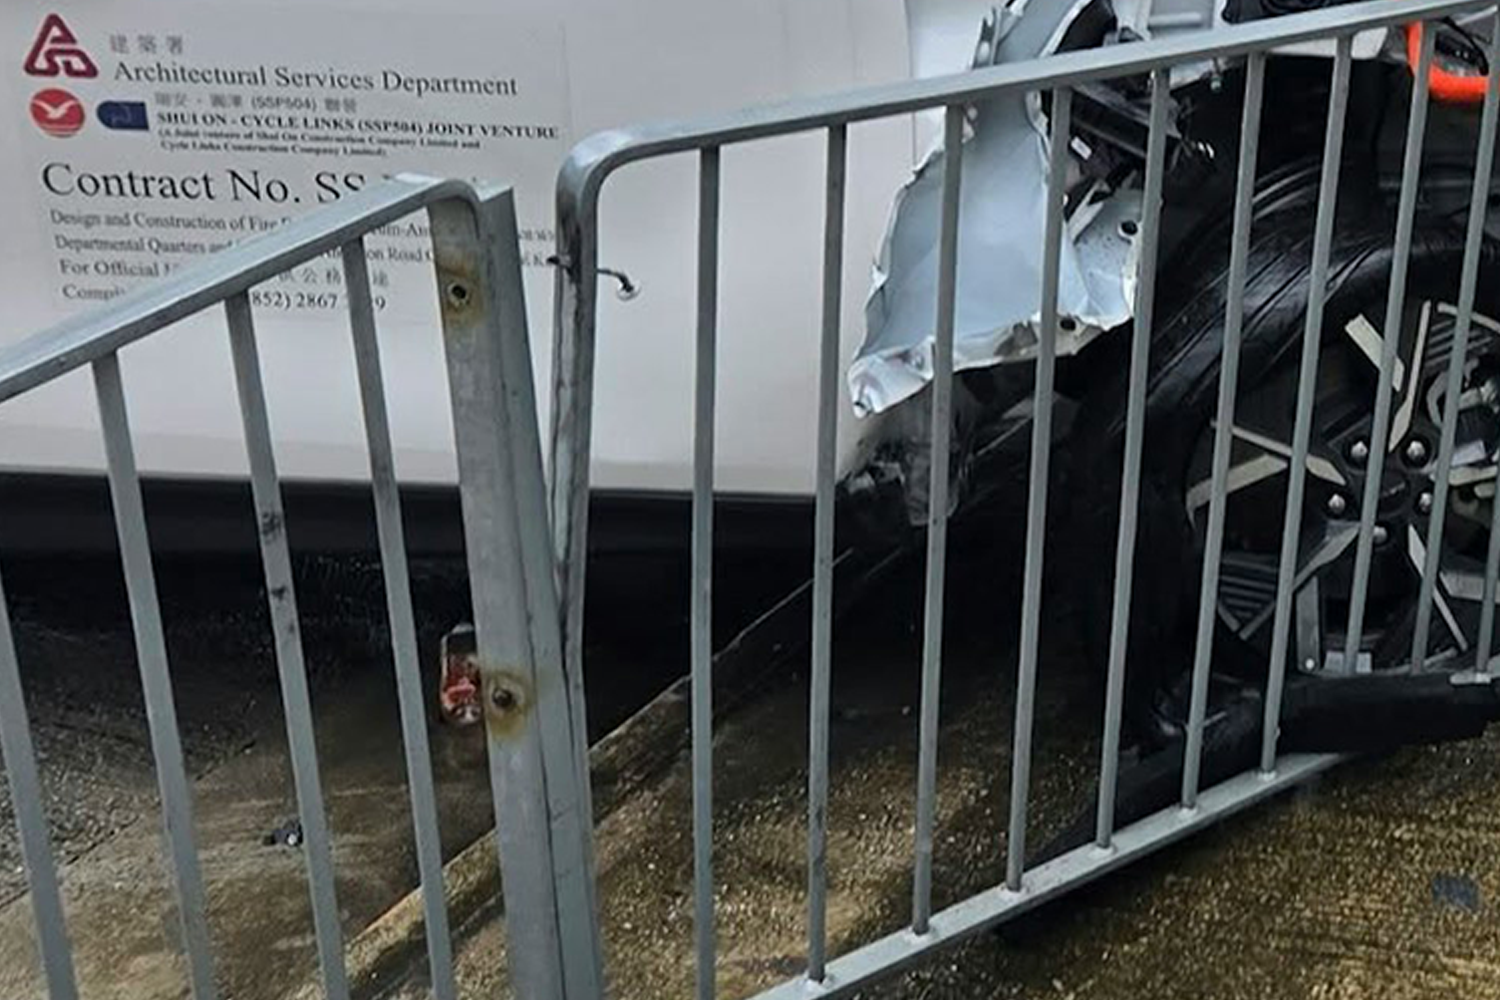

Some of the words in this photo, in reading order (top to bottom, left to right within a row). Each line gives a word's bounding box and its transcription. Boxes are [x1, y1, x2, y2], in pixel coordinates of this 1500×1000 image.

[114, 61, 267, 86] Architectural
[274, 67, 375, 89] Services
[382, 70, 518, 97] Department
[240, 115, 299, 129] CYCLE
[303, 117, 354, 131] LINKS
[426, 121, 476, 136] JOINT
[480, 123, 559, 139] VENTURE
[41, 161, 217, 201] Contract
[227, 168, 301, 204] No.
[51, 209, 101, 229] Design
[105, 211, 131, 227] and
[133, 212, 227, 231] Construction
[229, 214, 246, 231] of
[55, 234, 145, 253] Departmental
[148, 237, 206, 254] Quarters
[59, 259, 89, 275] For
[94, 260, 160, 278] Official
[296, 293, 339, 309] 2867
